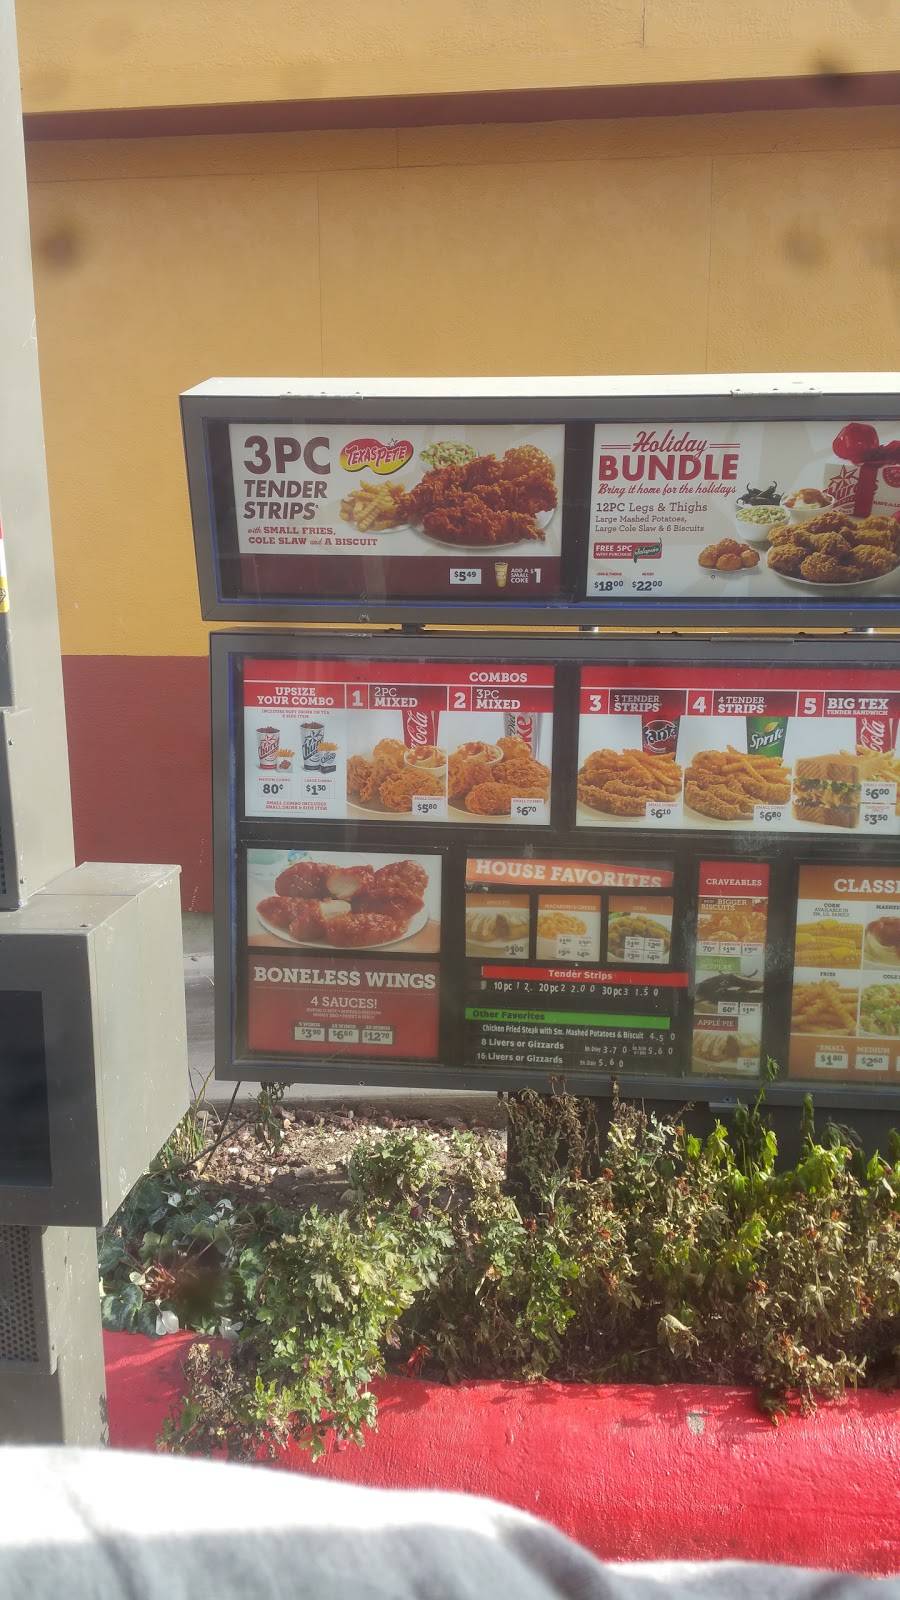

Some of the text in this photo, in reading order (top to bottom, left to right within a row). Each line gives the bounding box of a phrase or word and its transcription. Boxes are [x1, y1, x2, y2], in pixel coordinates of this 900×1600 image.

[631, 429, 708, 461] Holiday
[243, 435, 331, 475] 3PC
[598, 453, 740, 482] BUNDLE
[243, 480, 328, 499] TENDER
[597, 482, 737, 498] Bring it home for the holidays
[243, 501, 317, 520] STRIPS
[596, 501, 708, 514] 12PC Legs & Thighs
[595, 515, 688, 524] Large Mashed Potatoes,
[247, 526, 336, 536] with SMALL FRIES,
[595, 525, 618, 533] Large
[248, 536, 276, 545] COLE
[278, 536, 307, 545] SLAW
[324, 538, 333, 546] A
[335, 538, 378, 546] BISCUIT
[530, 568, 542, 584] $1
[469, 672, 528, 683] COMBOS
[275, 687, 316, 697] UPSIZE
[374, 686, 397, 697] 2PC
[476, 689, 500, 699] 3PC
[257, 696, 334, 706] YOUR COMBO
[352, 690, 363, 707] 1
[374, 697, 418, 707] MIXED
[453, 692, 466, 709] 2
[589, 695, 602, 712] 3
[621, 695, 660, 703] TENDER
[726, 696, 765, 704] TENDER
[827, 698, 890, 710] BIG TEX
[476, 700, 521, 710] MIXED
[613, 703, 661, 712] STRIPS
[693, 697, 706, 713] 4
[717, 704, 765, 714] STRIPS
[804, 698, 817, 715] 5
[750, 727, 784, 749] Sprite
[476, 859, 662, 887] HOUSE FAVORITES
[705, 878, 762, 886] CRAVEABLES
[254, 966, 437, 990] BONELESS WINGS
[548, 970, 613, 981] Tender Strips
[310, 996, 378, 1009] 4 SAUCES!
[472, 1010, 545, 1020] Other Favorites
[482, 1024, 505, 1032] Chicken
[506, 1025, 521, 1033] Fried
[521, 1025, 539, 1034] Steak
[539, 1026, 553, 1034] with
[553, 1027, 565, 1035] Sm.
[566, 1027, 588, 1036] Mashed
[589, 1029, 616, 1038] Potatoes
[617, 1030, 622, 1038] &
[623, 1030, 644, 1039] Biscuit
[481, 1038, 565, 1050] 8 Livers or Gizzards
[488, 1052, 514, 1061] Livers
[516, 1054, 525, 1062] or
[526, 1054, 563, 1064] Gizzards
